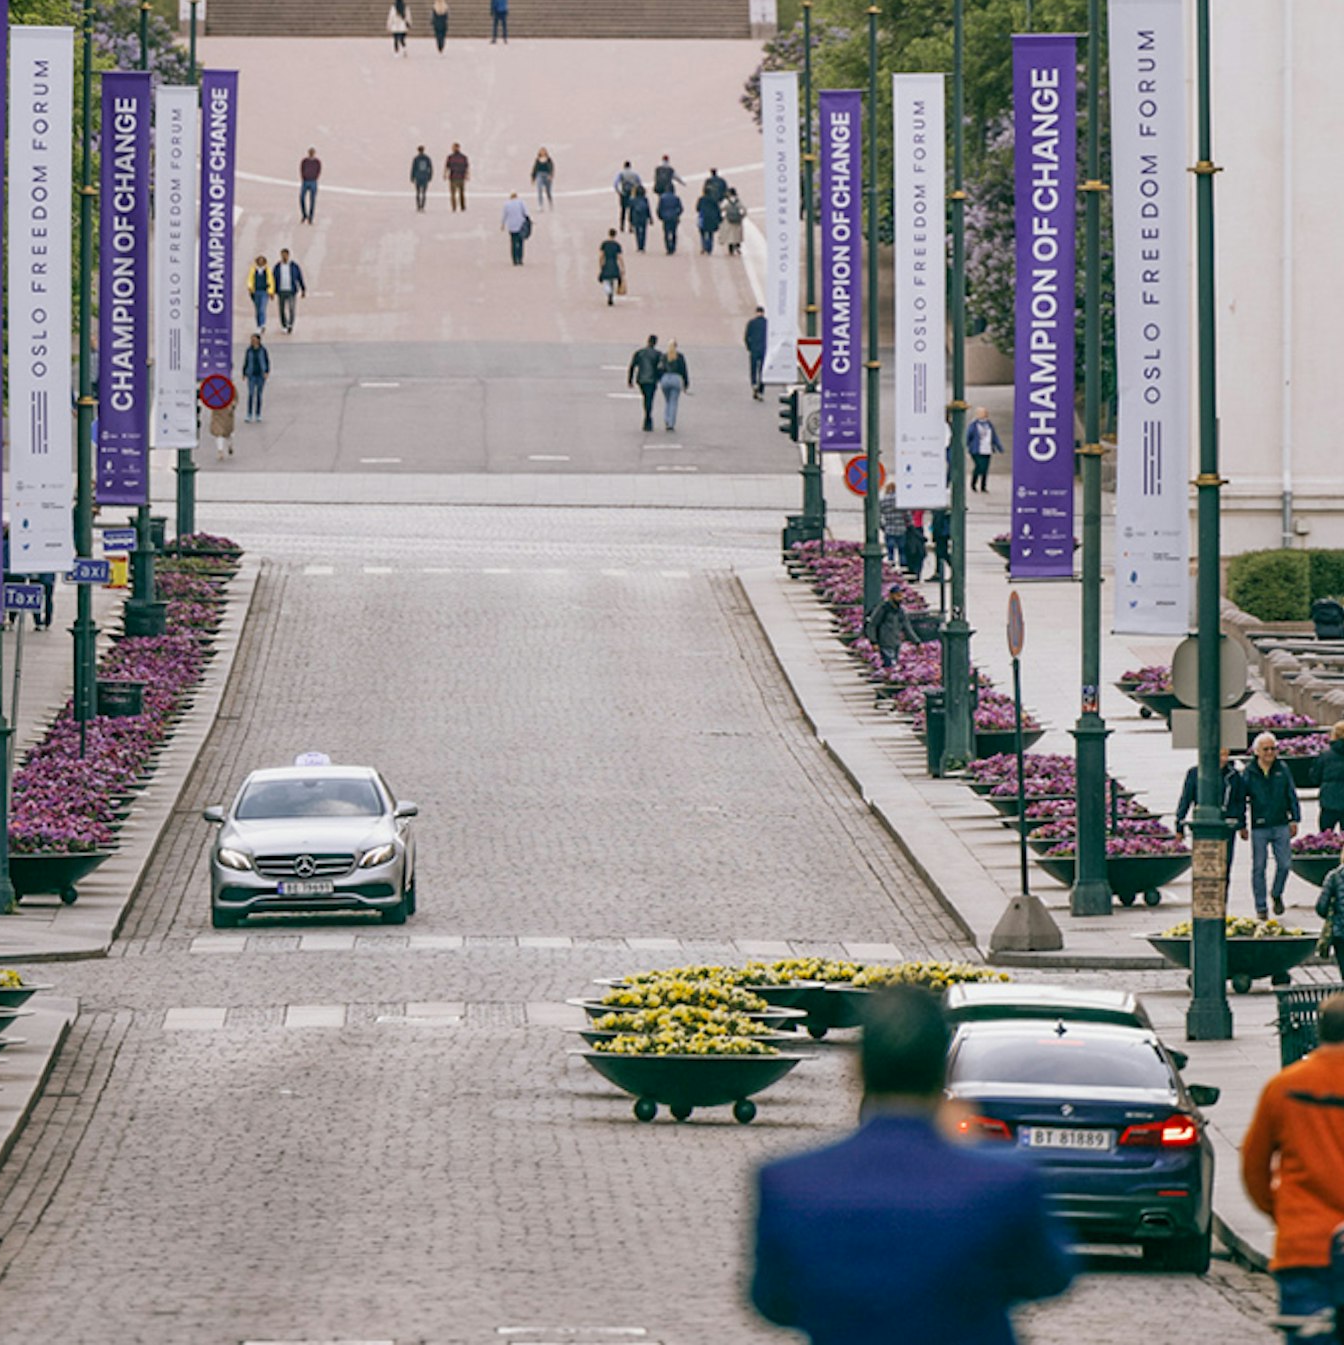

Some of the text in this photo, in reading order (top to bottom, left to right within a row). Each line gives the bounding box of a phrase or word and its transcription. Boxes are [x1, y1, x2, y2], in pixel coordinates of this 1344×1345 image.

[113, 97, 137, 213] CHANGE
[208, 87, 229, 171] CHANGE
[208, 172, 226, 200] OF
[775, 90, 788, 273] OSLO FREEDOM FORUM
[830, 111, 851, 209] CHANGE
[1031, 68, 1058, 212] CHANGE
[30, 60, 49, 378] OSLO FREEDOM FORUM
[112, 215, 134, 253] OF
[169, 108, 182, 320] OSLO FREEDOM FORUM
[206, 201, 225, 314] CHAMPION
[831, 210, 850, 242] OF
[912, 100, 927, 353] OSLO FREEDOM FORUM
[1032, 216, 1058, 262] OF
[1136, 30, 1161, 405] OSLO FREEDOM FORUM
[110, 257, 134, 412] CHAMPION
[831, 245, 851, 374] CHAMPION
[1028, 268, 1057, 462] CHAMPION
[7, 589, 42, 606] Taxi
[1034, 1130, 1054, 1144] BT
